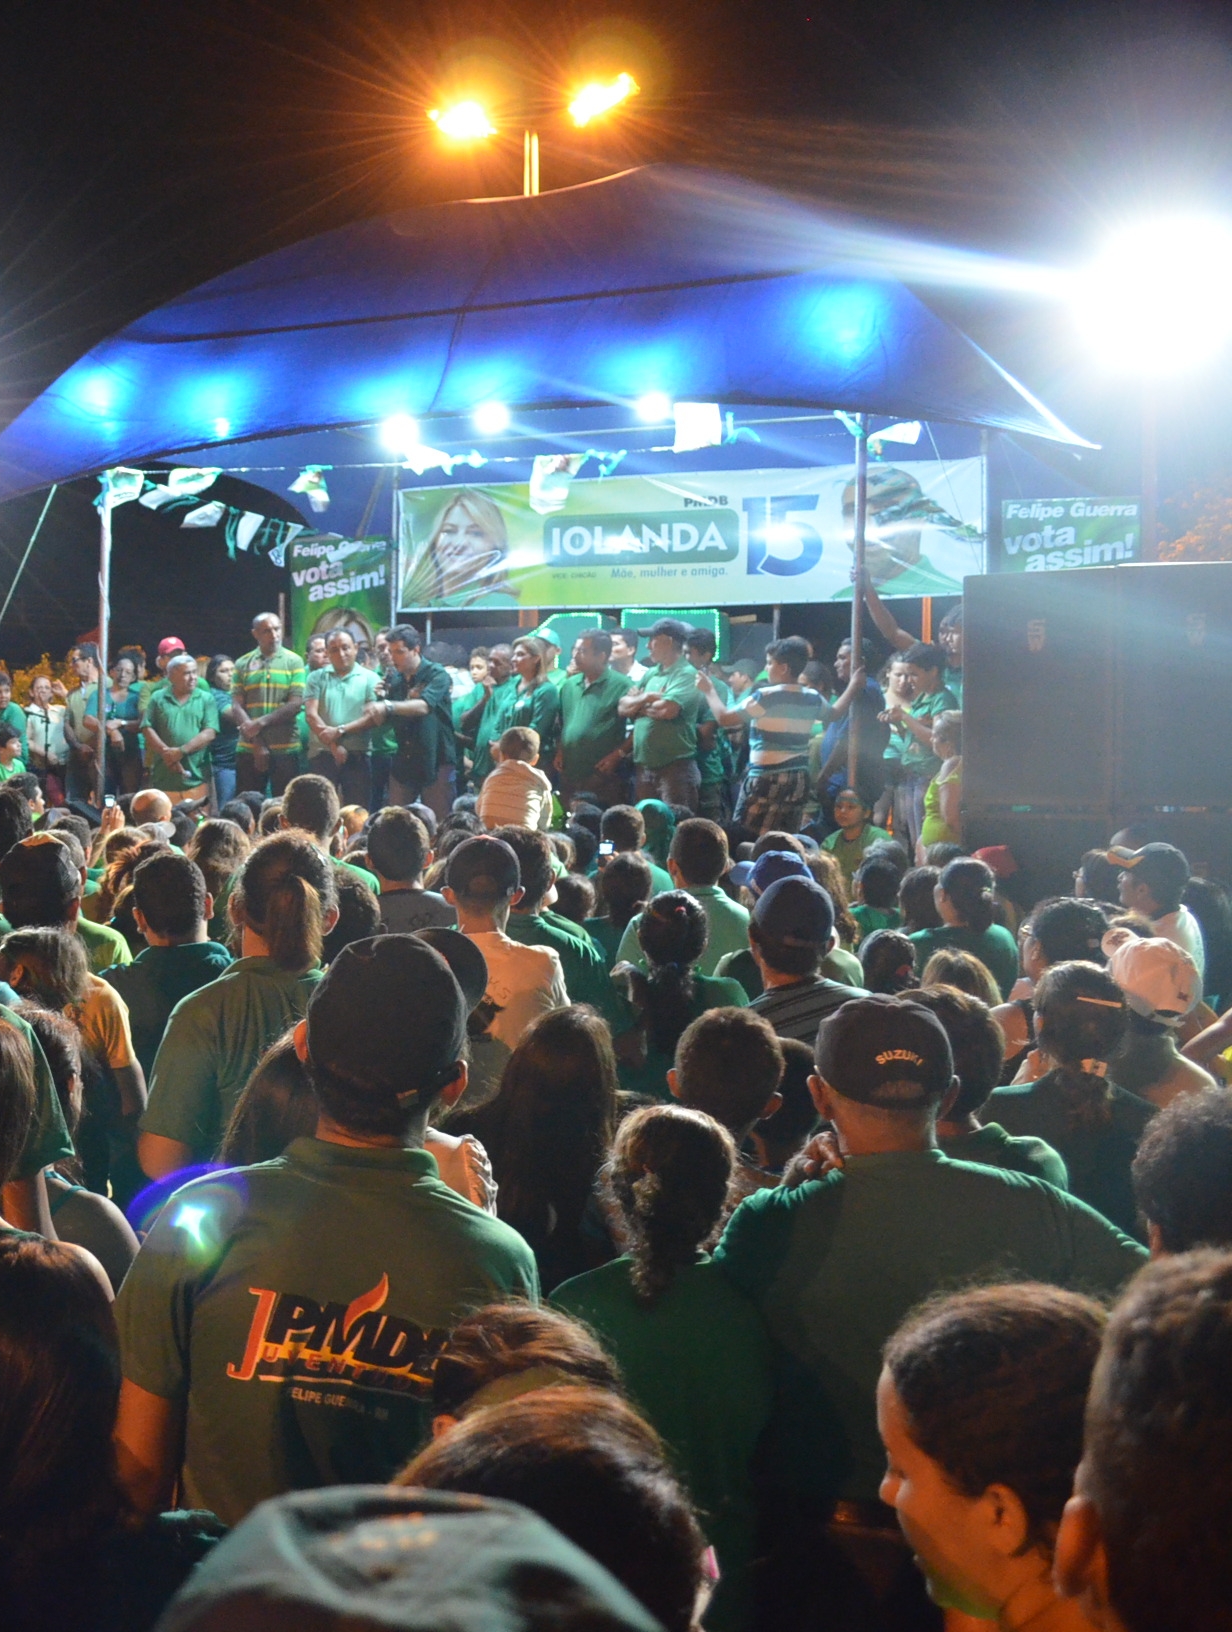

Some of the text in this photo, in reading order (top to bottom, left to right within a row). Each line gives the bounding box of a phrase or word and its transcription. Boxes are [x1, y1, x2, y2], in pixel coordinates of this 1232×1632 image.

[1006, 502, 1138, 521] Felipe Guerra
[551, 521, 728, 556] IOLANDA
[742, 494, 823, 577] 15
[1004, 525, 1075, 555] vota
[293, 543, 335, 558] Felipe
[1025, 533, 1134, 572] assim!
[292, 560, 344, 587] vota
[309, 564, 386, 602] assim!
[640, 565, 678, 578] mulher
[681, 569, 688, 577] e
[875, 1049, 923, 1066] SUZUKI
[286, 1386, 322, 1405] ELIPE
